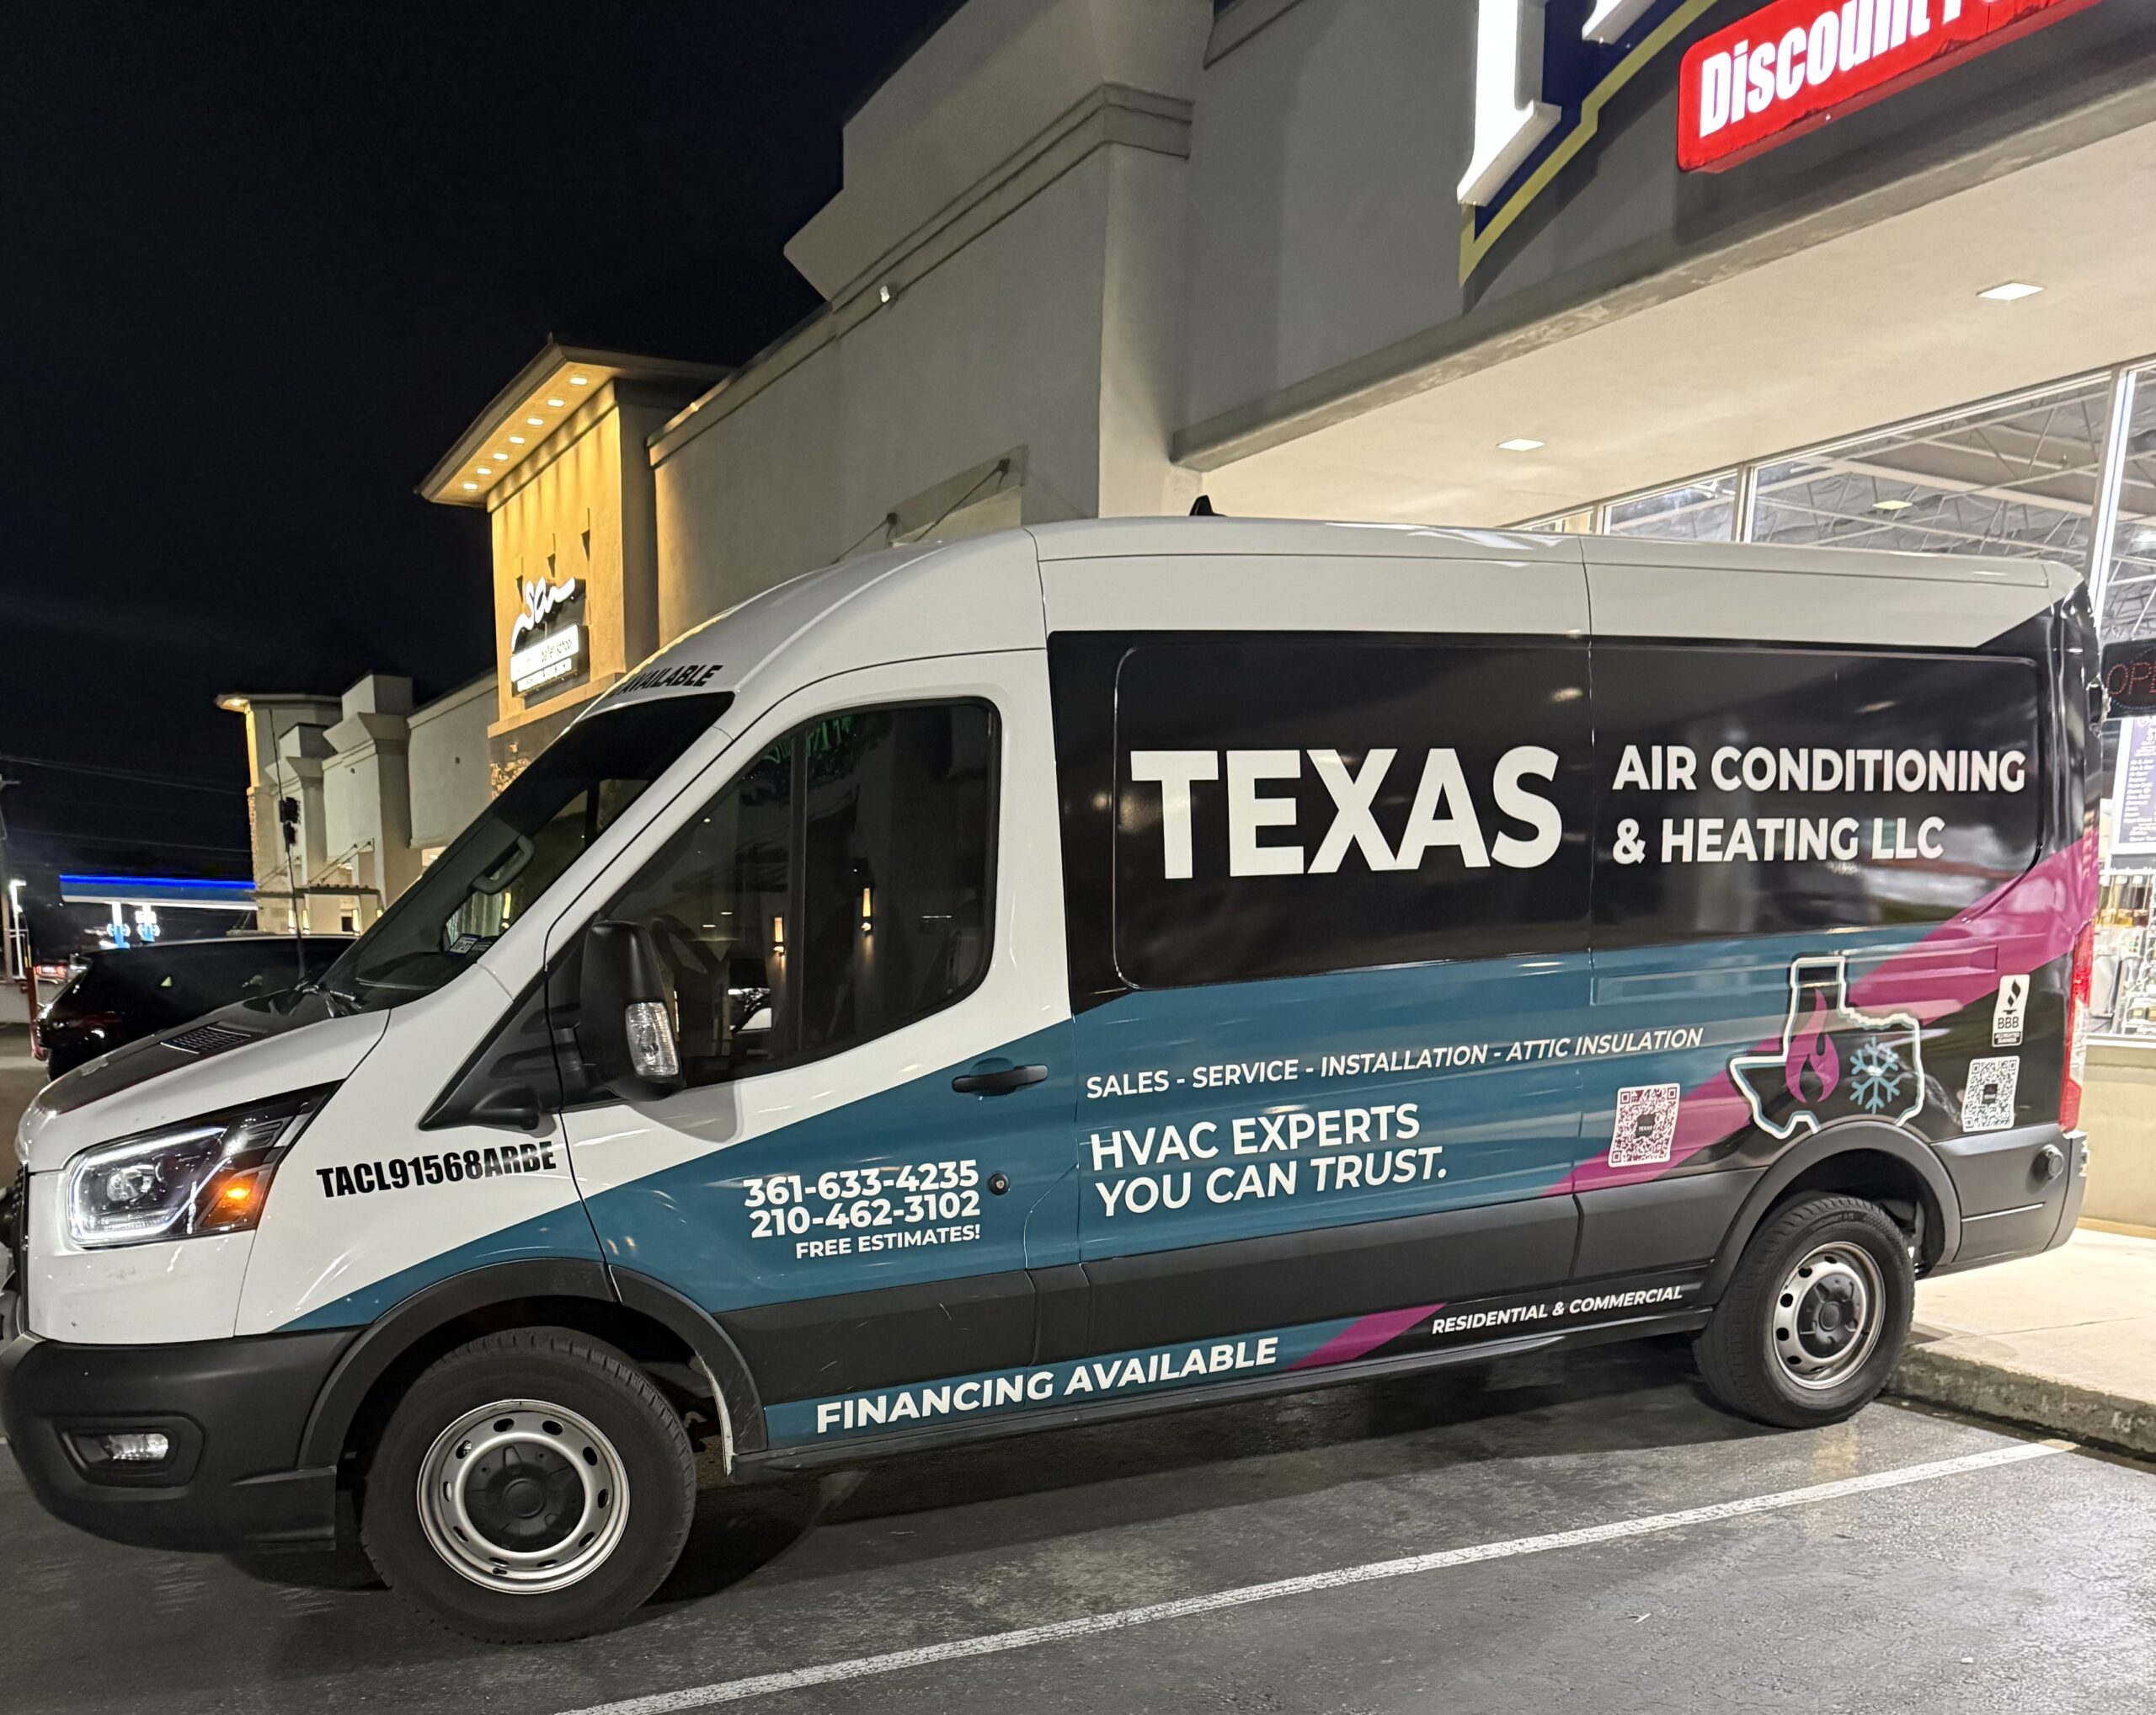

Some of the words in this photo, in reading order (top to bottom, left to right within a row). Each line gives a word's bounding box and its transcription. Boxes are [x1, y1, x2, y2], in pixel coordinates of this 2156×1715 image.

[616, 665, 723, 696] AVAILABLE
[1612, 745, 1697, 790] AIR
[1710, 745, 2026, 792] CONDITIONING
[1130, 745, 1562, 879] TEXAS
[1612, 818, 1646, 864] &
[1661, 817, 1860, 863] HEATING
[1871, 816, 1945, 859] LLC
[1998, 1017, 2020, 1029] BBB
[1086, 1070, 1169, 1098] SALES
[1192, 1059, 1299, 1088] SERVICE
[1321, 1044, 1488, 1077] INSTALLATION
[1506, 1037, 1572, 1061] ATTIC
[1574, 1027, 1705, 1056] INSULATION
[1091, 1121, 1219, 1171] HVAC
[1232, 1103, 1420, 1155] EXPERTS
[316, 1141, 557, 1198] TACL91568ARBE
[743, 1159, 979, 1208] 361-633-4235
[1095, 1172, 1192, 1217] YOU
[1206, 1160, 1297, 1204] CAN
[1310, 1146, 1448, 1192] TRUST.
[749, 1189, 980, 1238] 210-462-3102
[796, 1237, 852, 1259] FREE
[857, 1223, 980, 1253] ESTIMATES!
[1432, 1303, 1548, 1334] RESIDENTIAL
[1551, 1301, 1565, 1317] &
[1569, 1285, 1683, 1314] COMMERCIAL
[817, 1371, 1054, 1434] FINANCING
[1064, 1337, 1278, 1396] AVAILABLE
